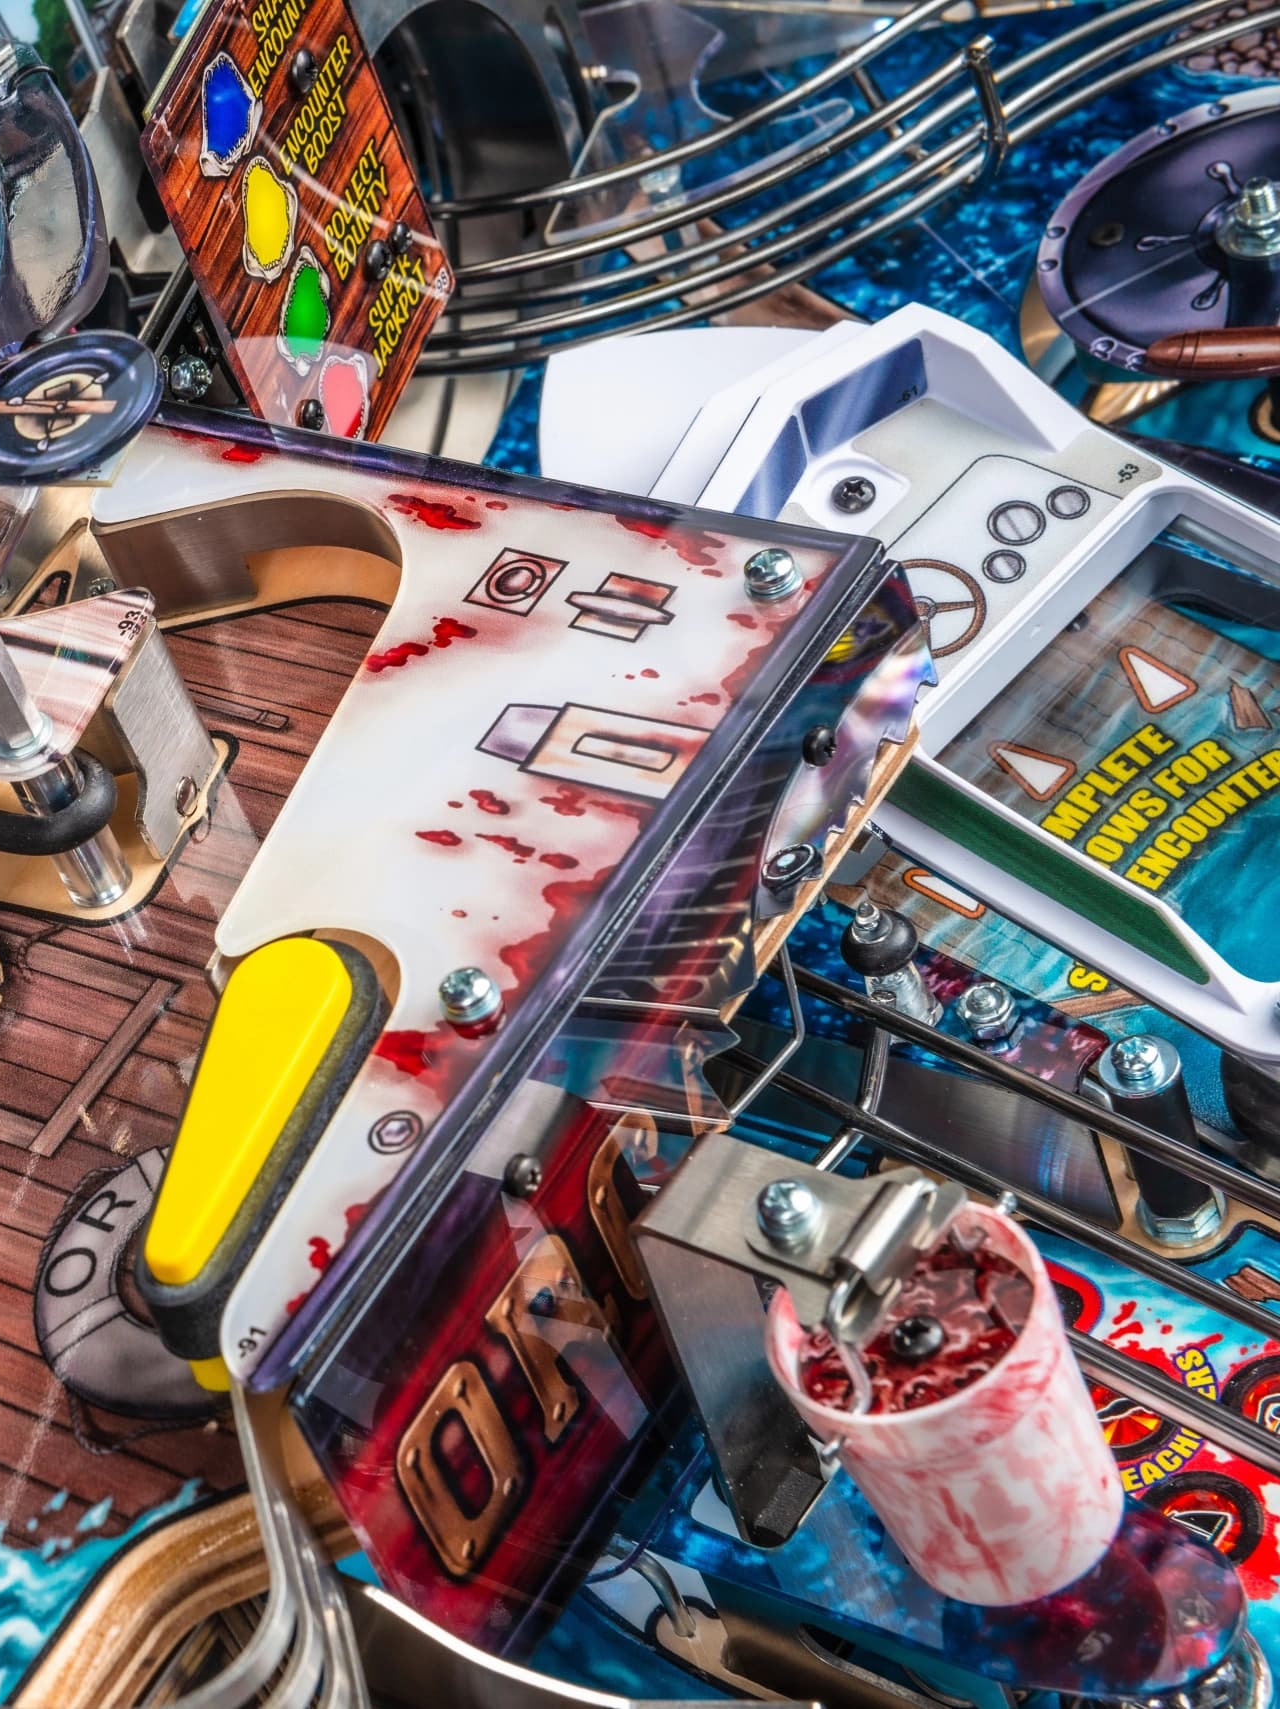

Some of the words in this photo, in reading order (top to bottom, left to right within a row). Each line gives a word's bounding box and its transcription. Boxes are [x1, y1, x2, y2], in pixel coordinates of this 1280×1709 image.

[279, 35, 351, 176] ENCOUNTER
[303, 86, 346, 175] BOOST
[324, 139, 380, 253] COLLECT
[334, 166, 388, 280] BOUNTY
[369, 253, 410, 338] SUPER
[372, 258, 425, 378] JACKPOT
[1118, 463, 1140, 483] -53
[1040, 725, 1175, 841] MPLETE
[1086, 788, 1168, 870] OWS
[1152, 740, 1232, 798] FOR
[238, 1327, 267, 1358] -91
